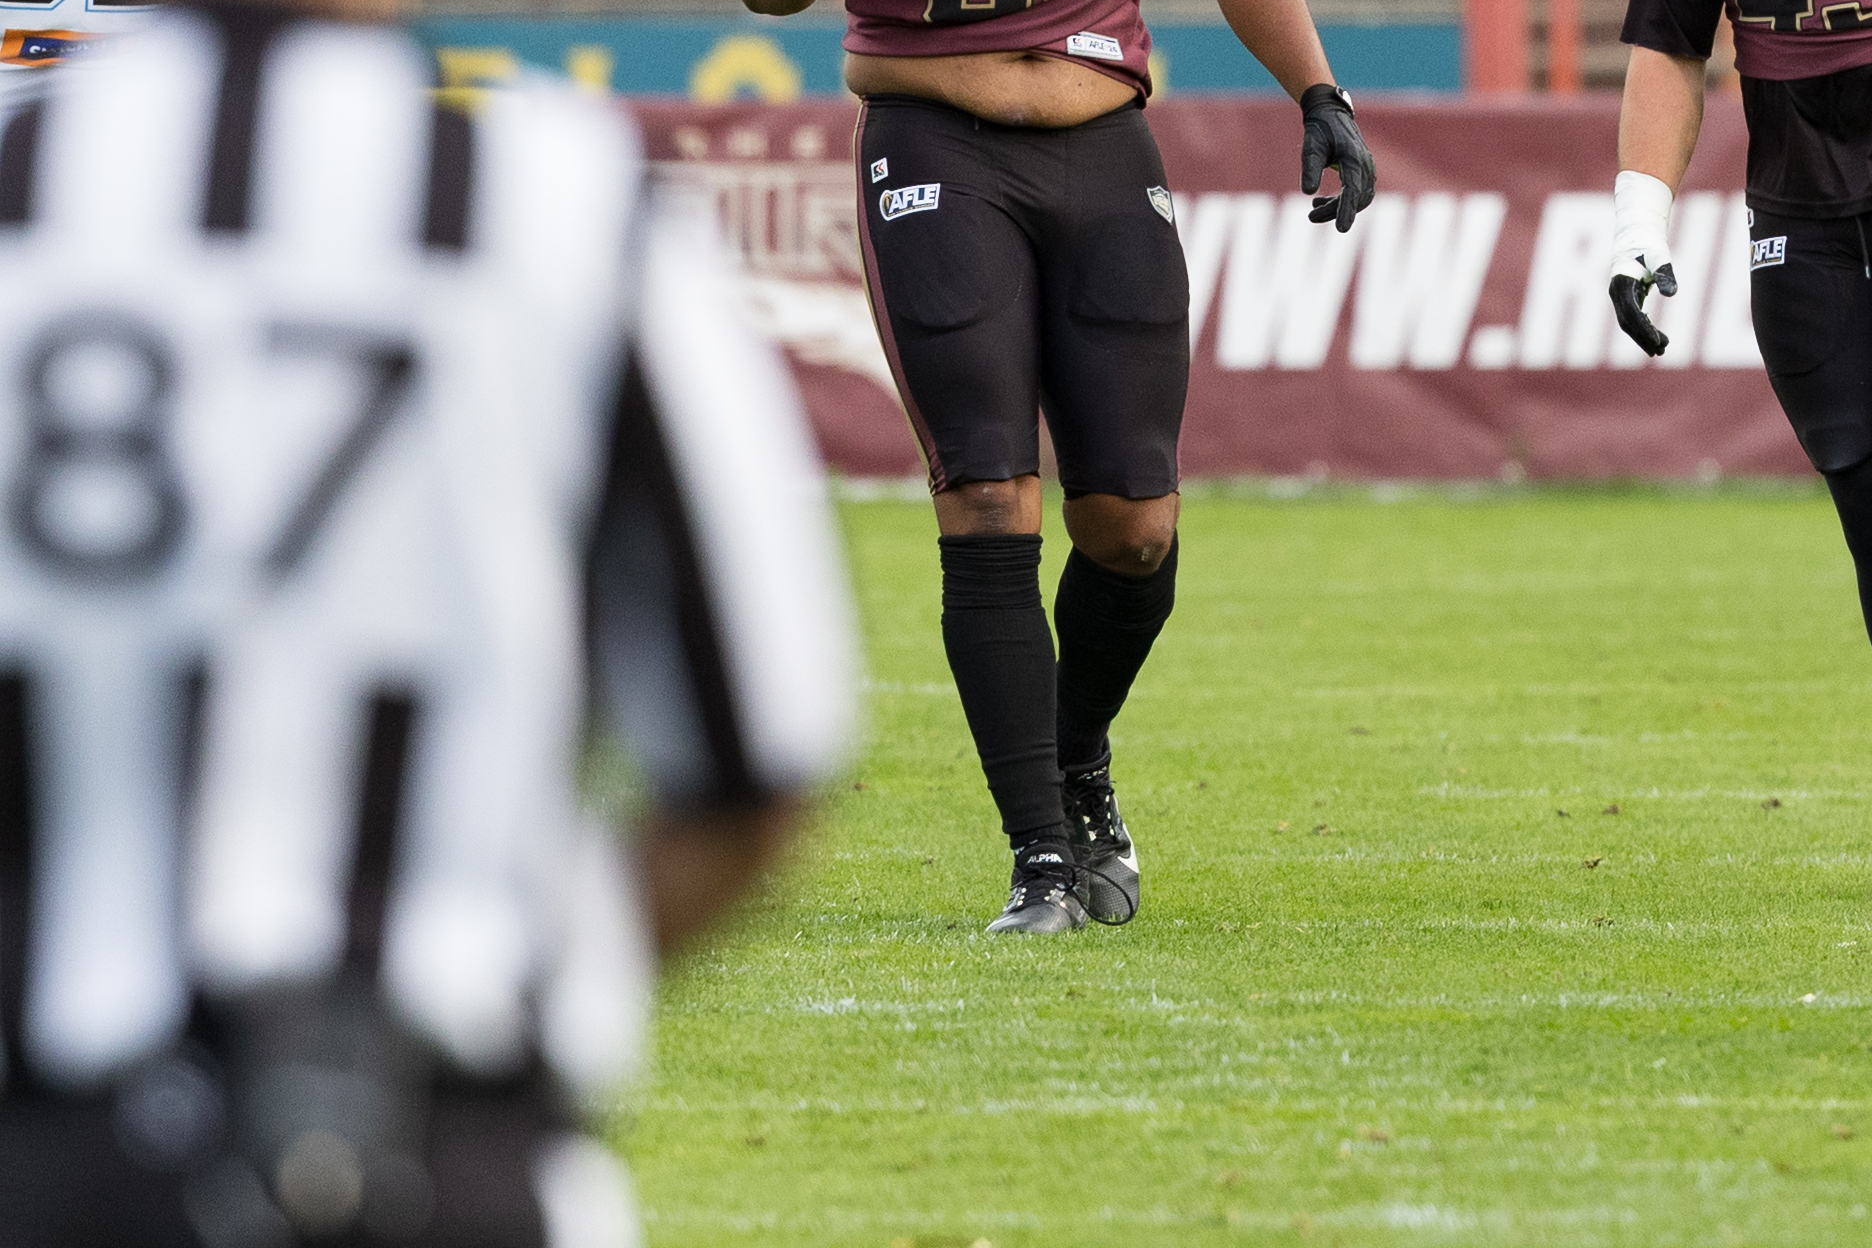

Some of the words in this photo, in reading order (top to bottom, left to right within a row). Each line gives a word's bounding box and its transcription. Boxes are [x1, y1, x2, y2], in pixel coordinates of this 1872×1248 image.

[888, 186, 937, 215] AFLE
[1753, 239, 1783, 263] AFLE
[6, 309, 424, 595] 87
[1026, 853, 1064, 864] ALPHA
